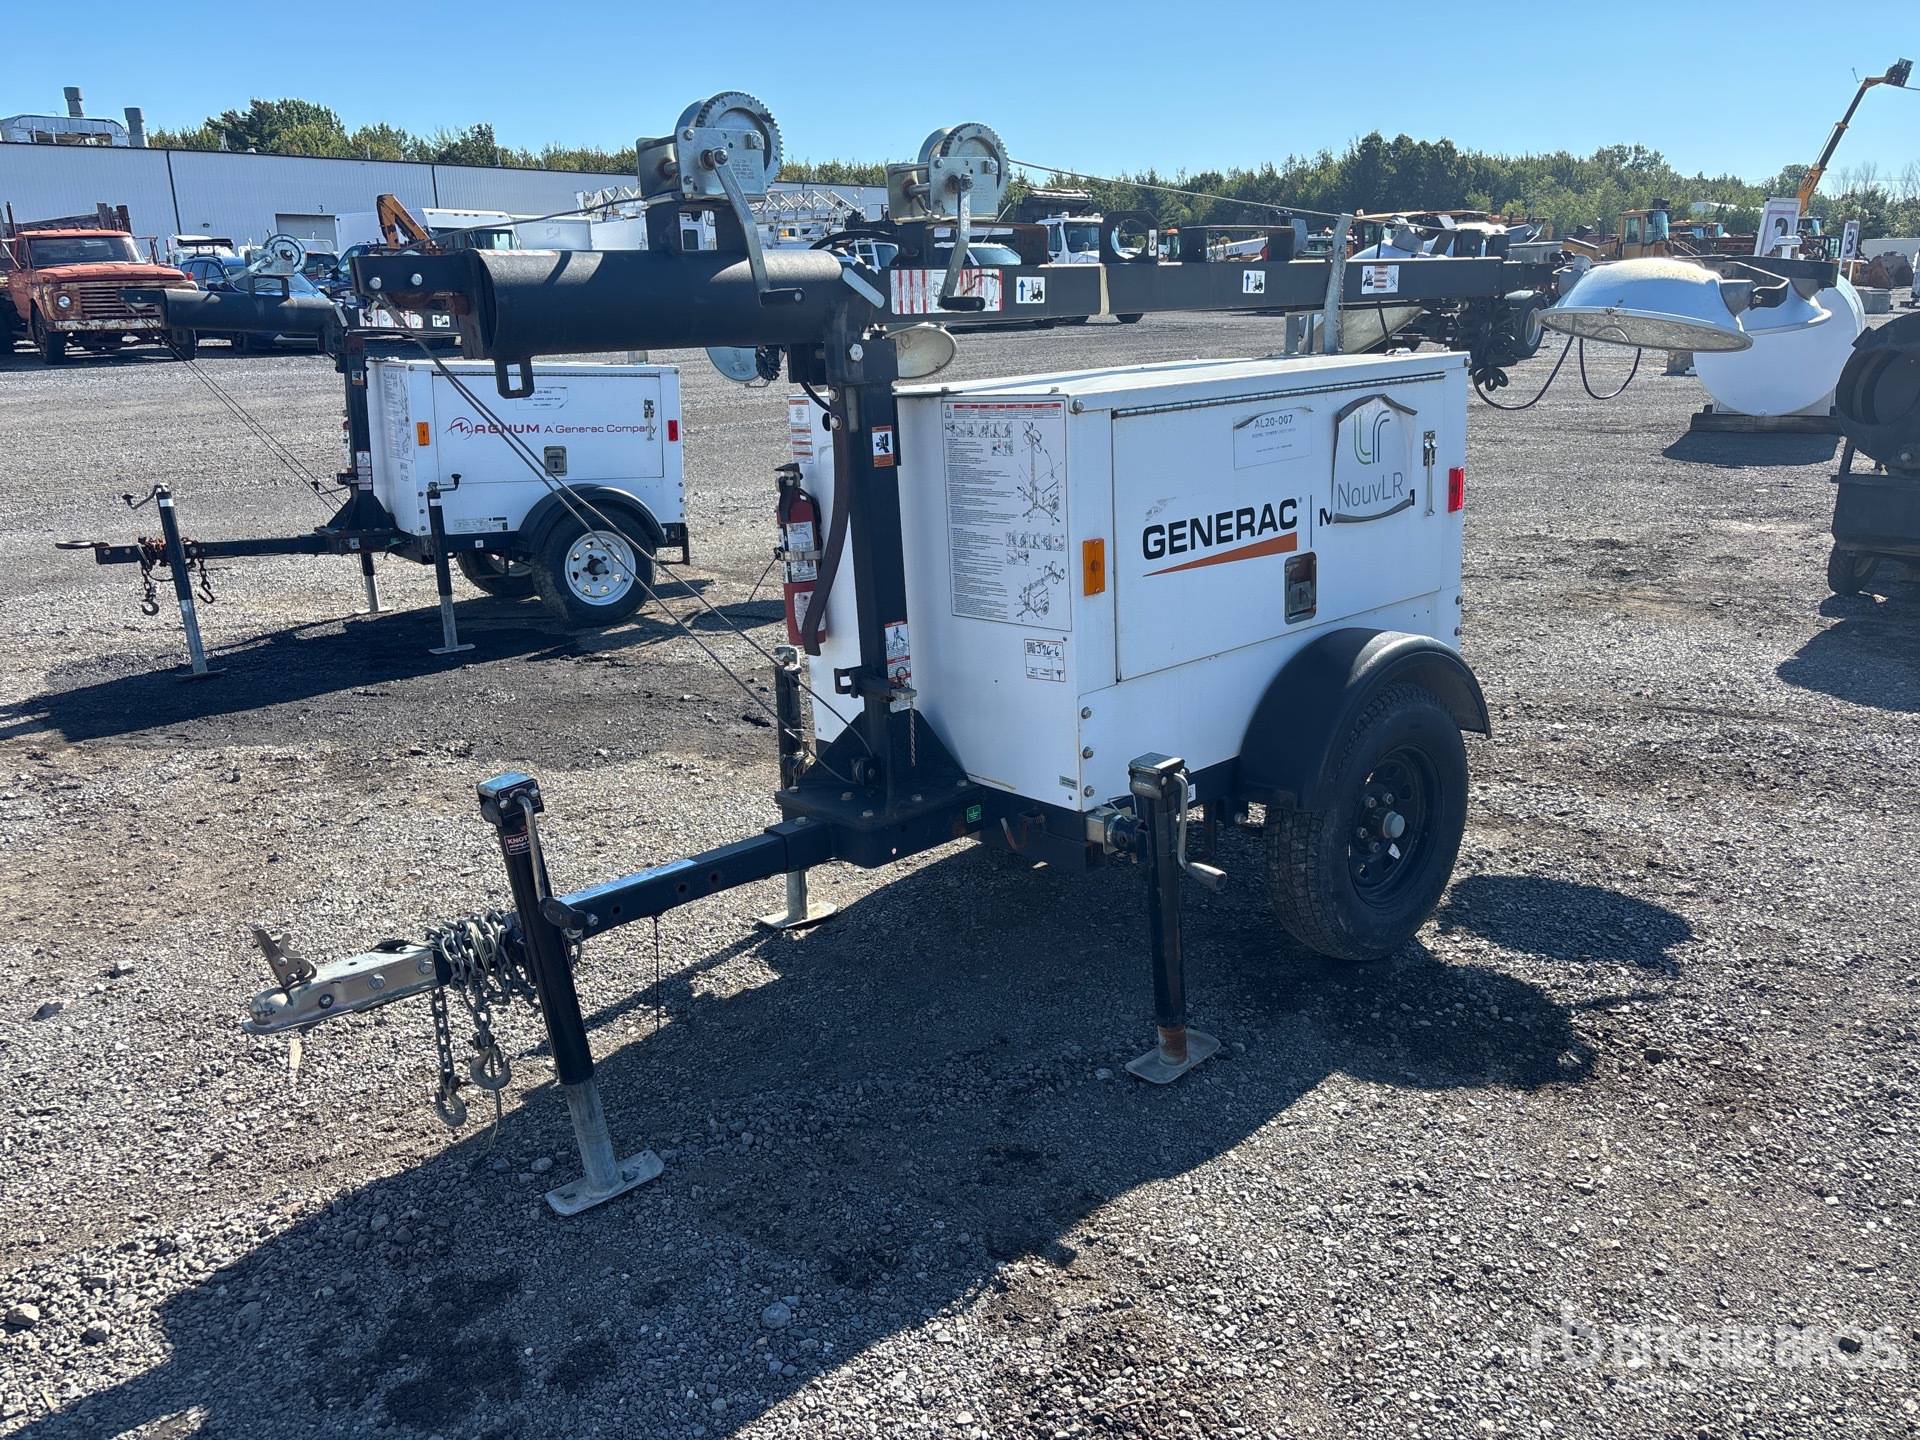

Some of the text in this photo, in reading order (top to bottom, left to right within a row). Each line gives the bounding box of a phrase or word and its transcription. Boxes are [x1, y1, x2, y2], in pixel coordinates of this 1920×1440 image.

[318, 205, 324, 214] 3
[1845, 231, 1855, 254] 3
[444, 417, 658, 440] MAGNUM A Generac Company
[1254, 414, 1293, 429] AL20-007
[1337, 472, 1403, 510] NouvLR
[1142, 498, 1298, 560] GENERAC
